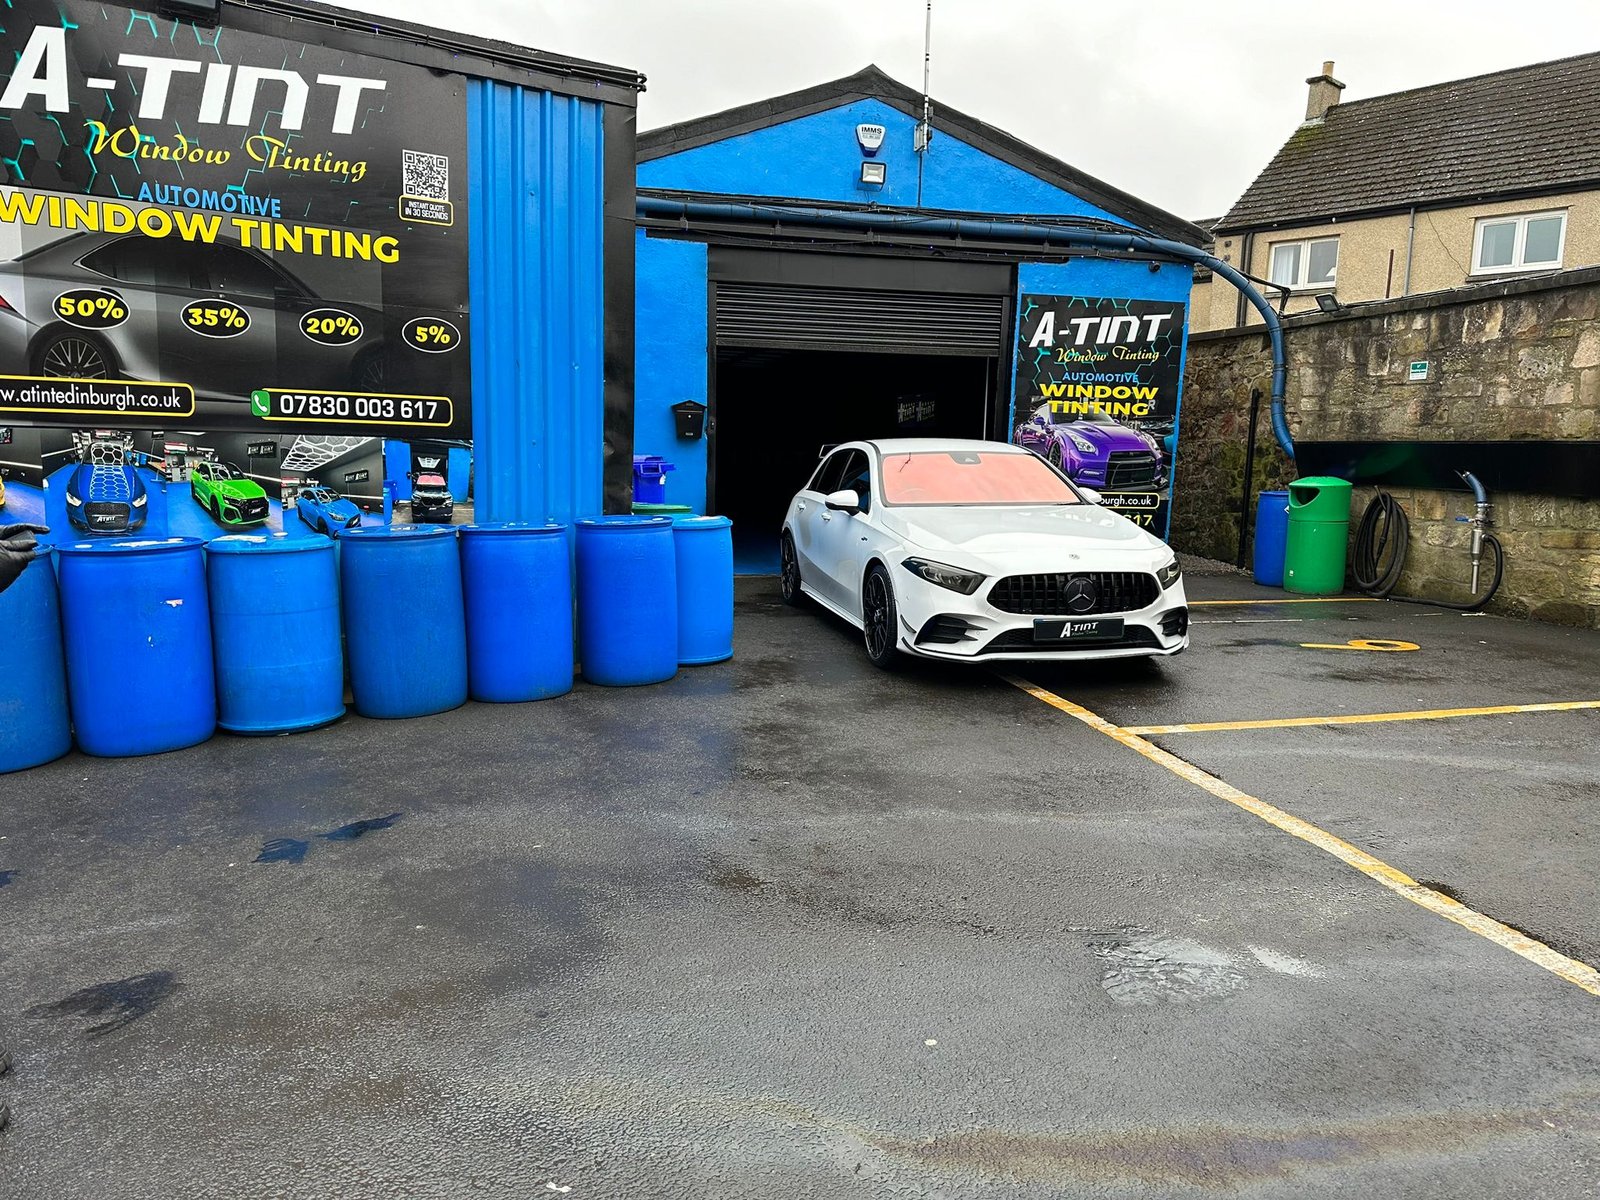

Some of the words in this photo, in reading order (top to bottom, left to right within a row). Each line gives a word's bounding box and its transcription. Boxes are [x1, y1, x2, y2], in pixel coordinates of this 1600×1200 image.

[861, 126, 882, 134] IMMS
[83, 120, 231, 166] Window
[245, 135, 367, 183] Tinting
[138, 182, 281, 218] AUTOMOTIVE
[408, 200, 429, 210] INSTANT
[429, 203, 445, 212] QUOTE
[405, 207, 411, 216] IN
[412, 208, 421, 217] 30
[421, 209, 449, 220] SECONDS
[0, 190, 222, 244] WINDOW
[231, 219, 399, 263] TINTING
[58, 296, 125, 321] 50%
[187, 308, 246, 329] 35%
[306, 318, 360, 337] 20%
[415, 326, 450, 345] 5%
[1028, 311, 1172, 348] A-TINT
[1055, 348, 1107, 363] Window
[1112, 346, 1160, 363] Tinting
[1062, 372, 1139, 383] AUTOMOTIVE
[0, 383, 181, 410] w.atintedinburgh.co.uk
[1039, 384, 1159, 400] WINDOW
[280, 394, 350, 415] 07830
[355, 396, 394, 418] 003
[400, 399, 437, 420] 617
[1046, 400, 1149, 416] TINTING
